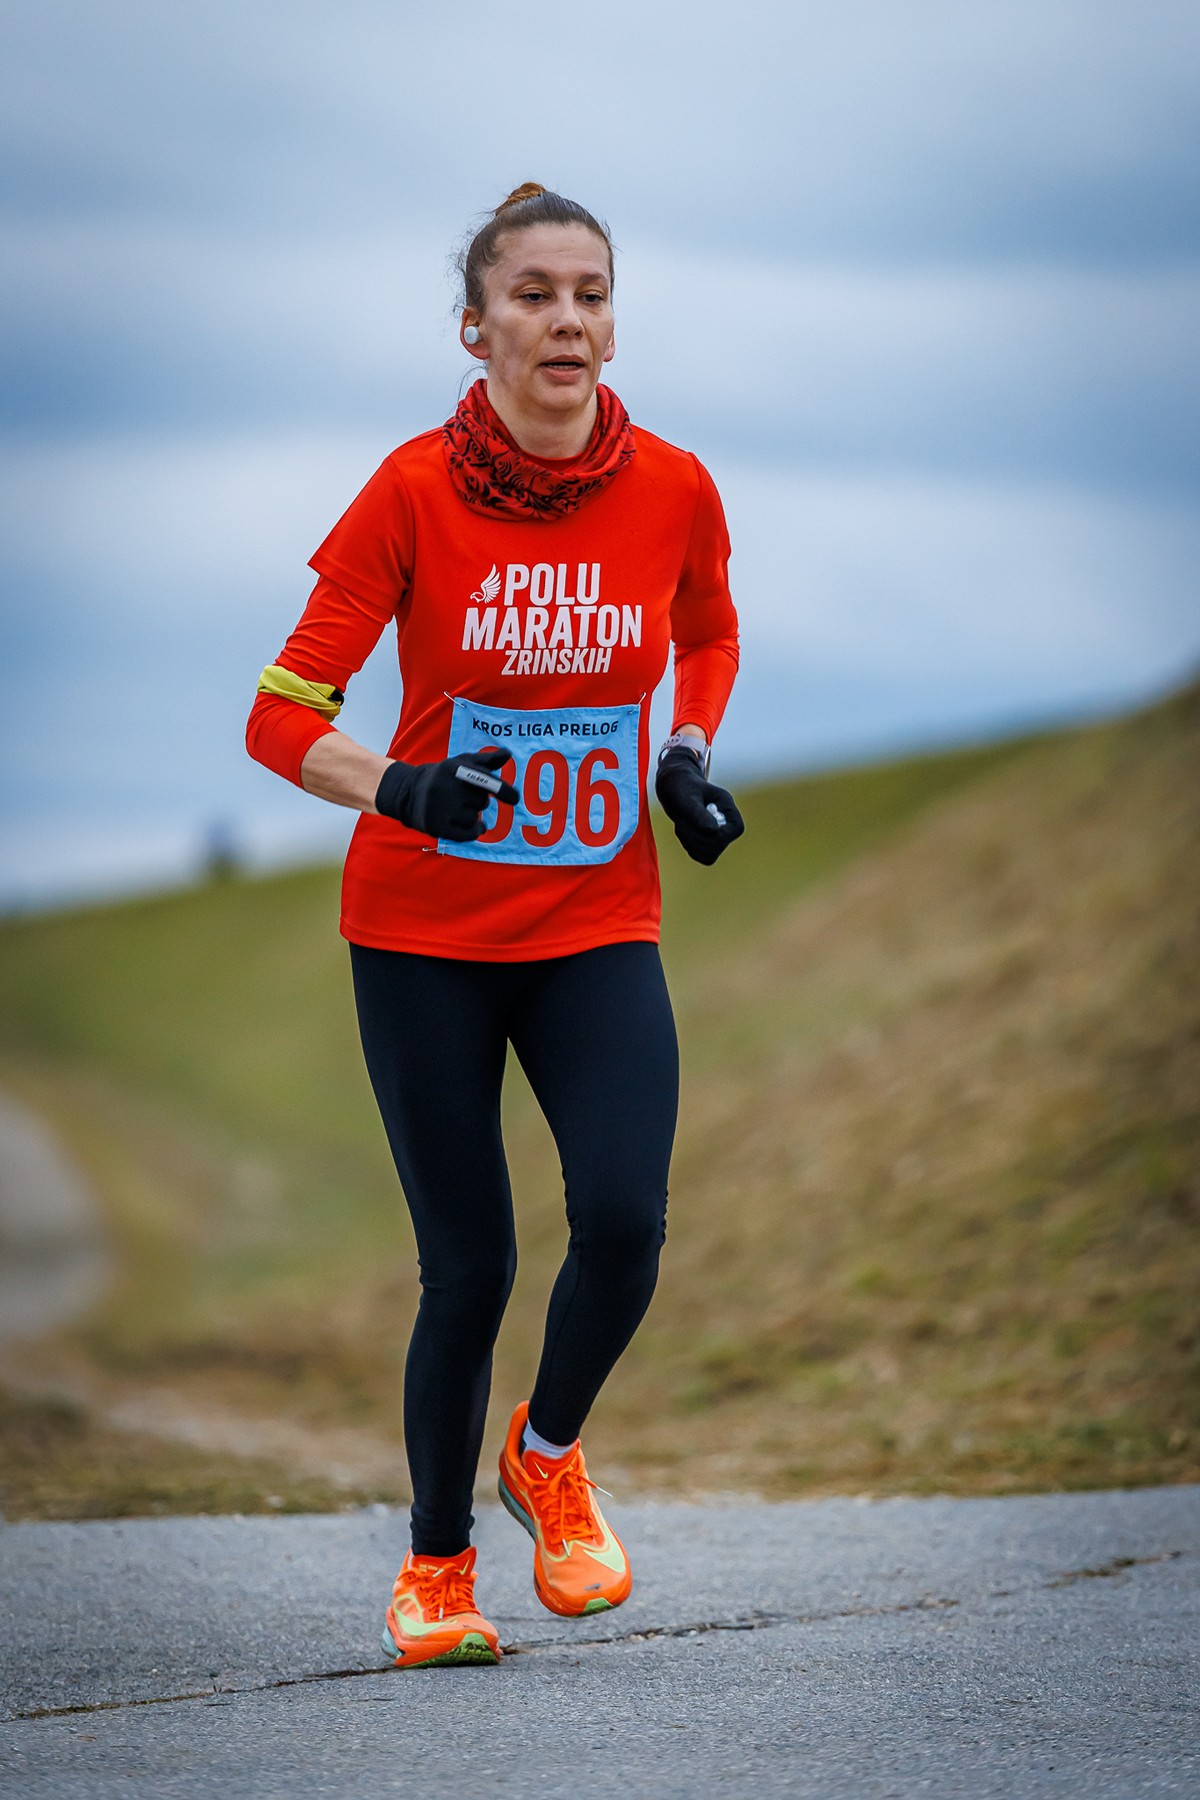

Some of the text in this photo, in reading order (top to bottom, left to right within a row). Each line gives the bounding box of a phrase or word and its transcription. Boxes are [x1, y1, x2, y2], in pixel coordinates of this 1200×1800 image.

[503, 562, 601, 607] POLU
[461, 604, 643, 651] MARATON
[501, 647, 613, 676] ZRINSKIH
[472, 717, 619, 737] KROS LIGA PRELOG
